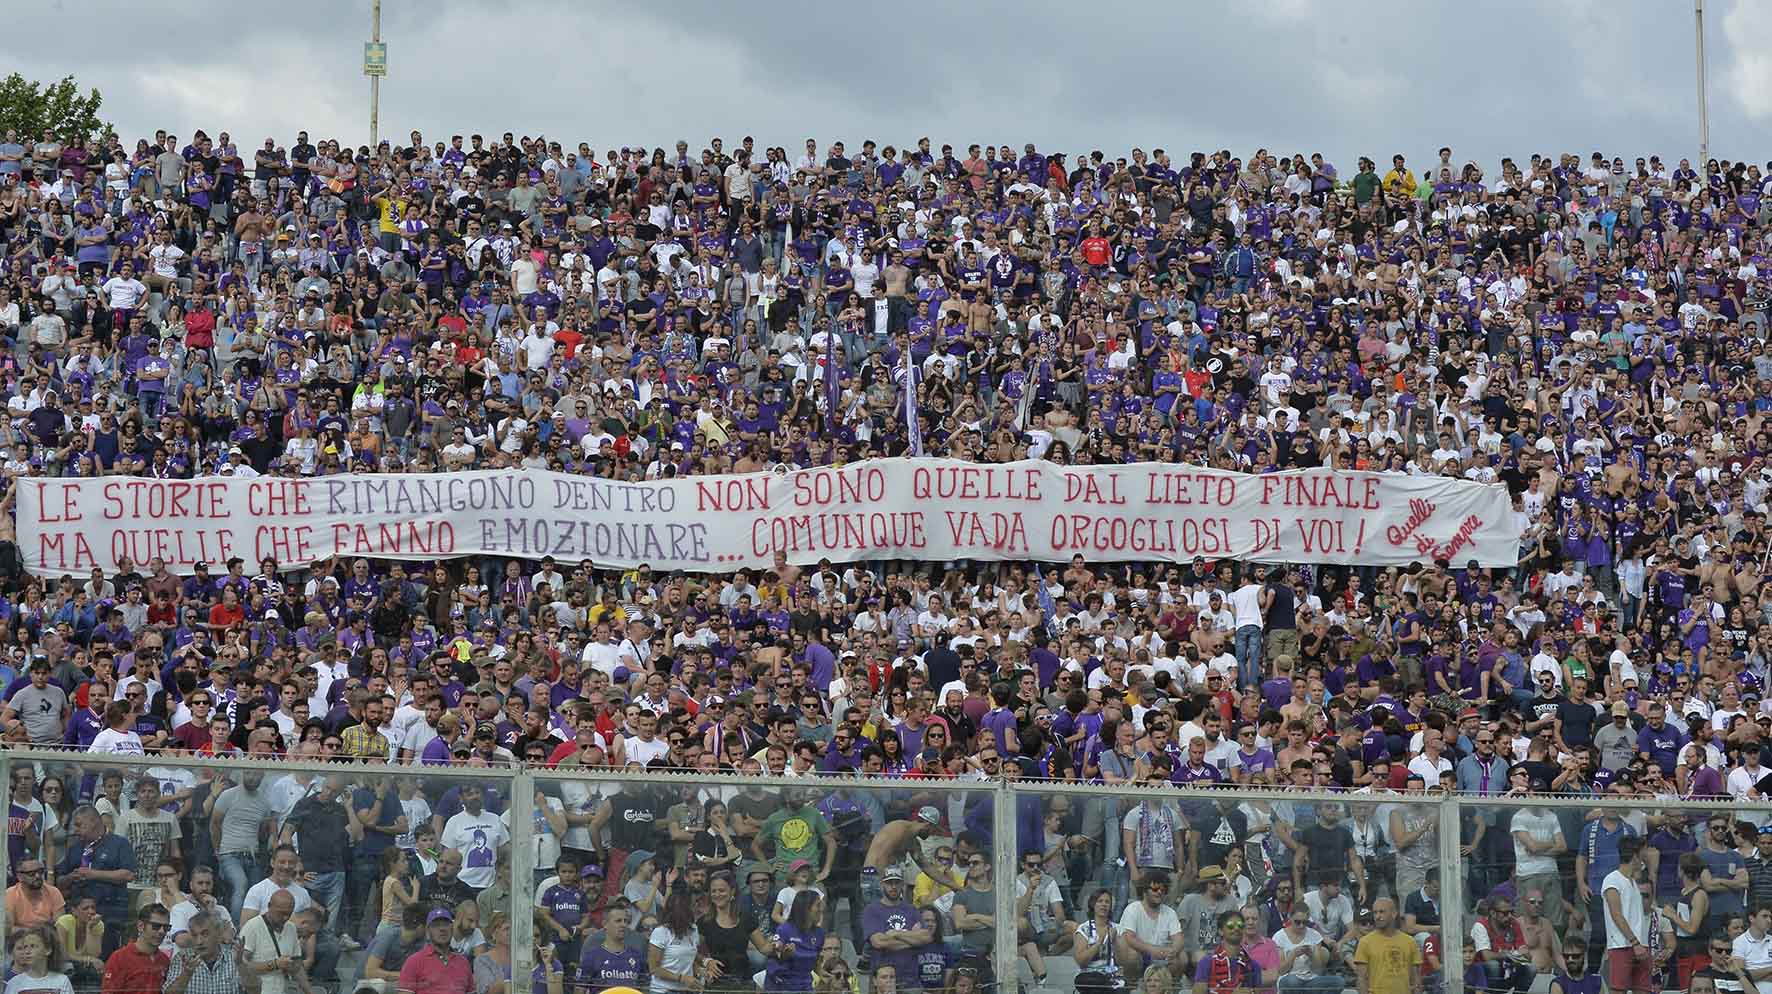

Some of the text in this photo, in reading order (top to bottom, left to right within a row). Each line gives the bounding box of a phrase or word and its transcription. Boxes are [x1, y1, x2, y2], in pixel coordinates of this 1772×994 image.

[37, 467, 1381, 522] LE STORIE CHE RIMANGONO DENTRO NON SONO QUELLE DAL LIETO FINALE
[39, 531, 98, 569] MA
[111, 528, 237, 568] QUELLE
[255, 524, 317, 566] CHE
[331, 519, 455, 554] FANNO
[752, 511, 926, 558] COMUNQUE
[945, 511, 1029, 552] VADA
[1051, 513, 1232, 554] ORGOGLIOSI
[1250, 518, 1281, 553] DI
[1386, 498, 1437, 546] Quelli
[1413, 533, 1435, 555] di
[1425, 942, 1434, 953] 2
